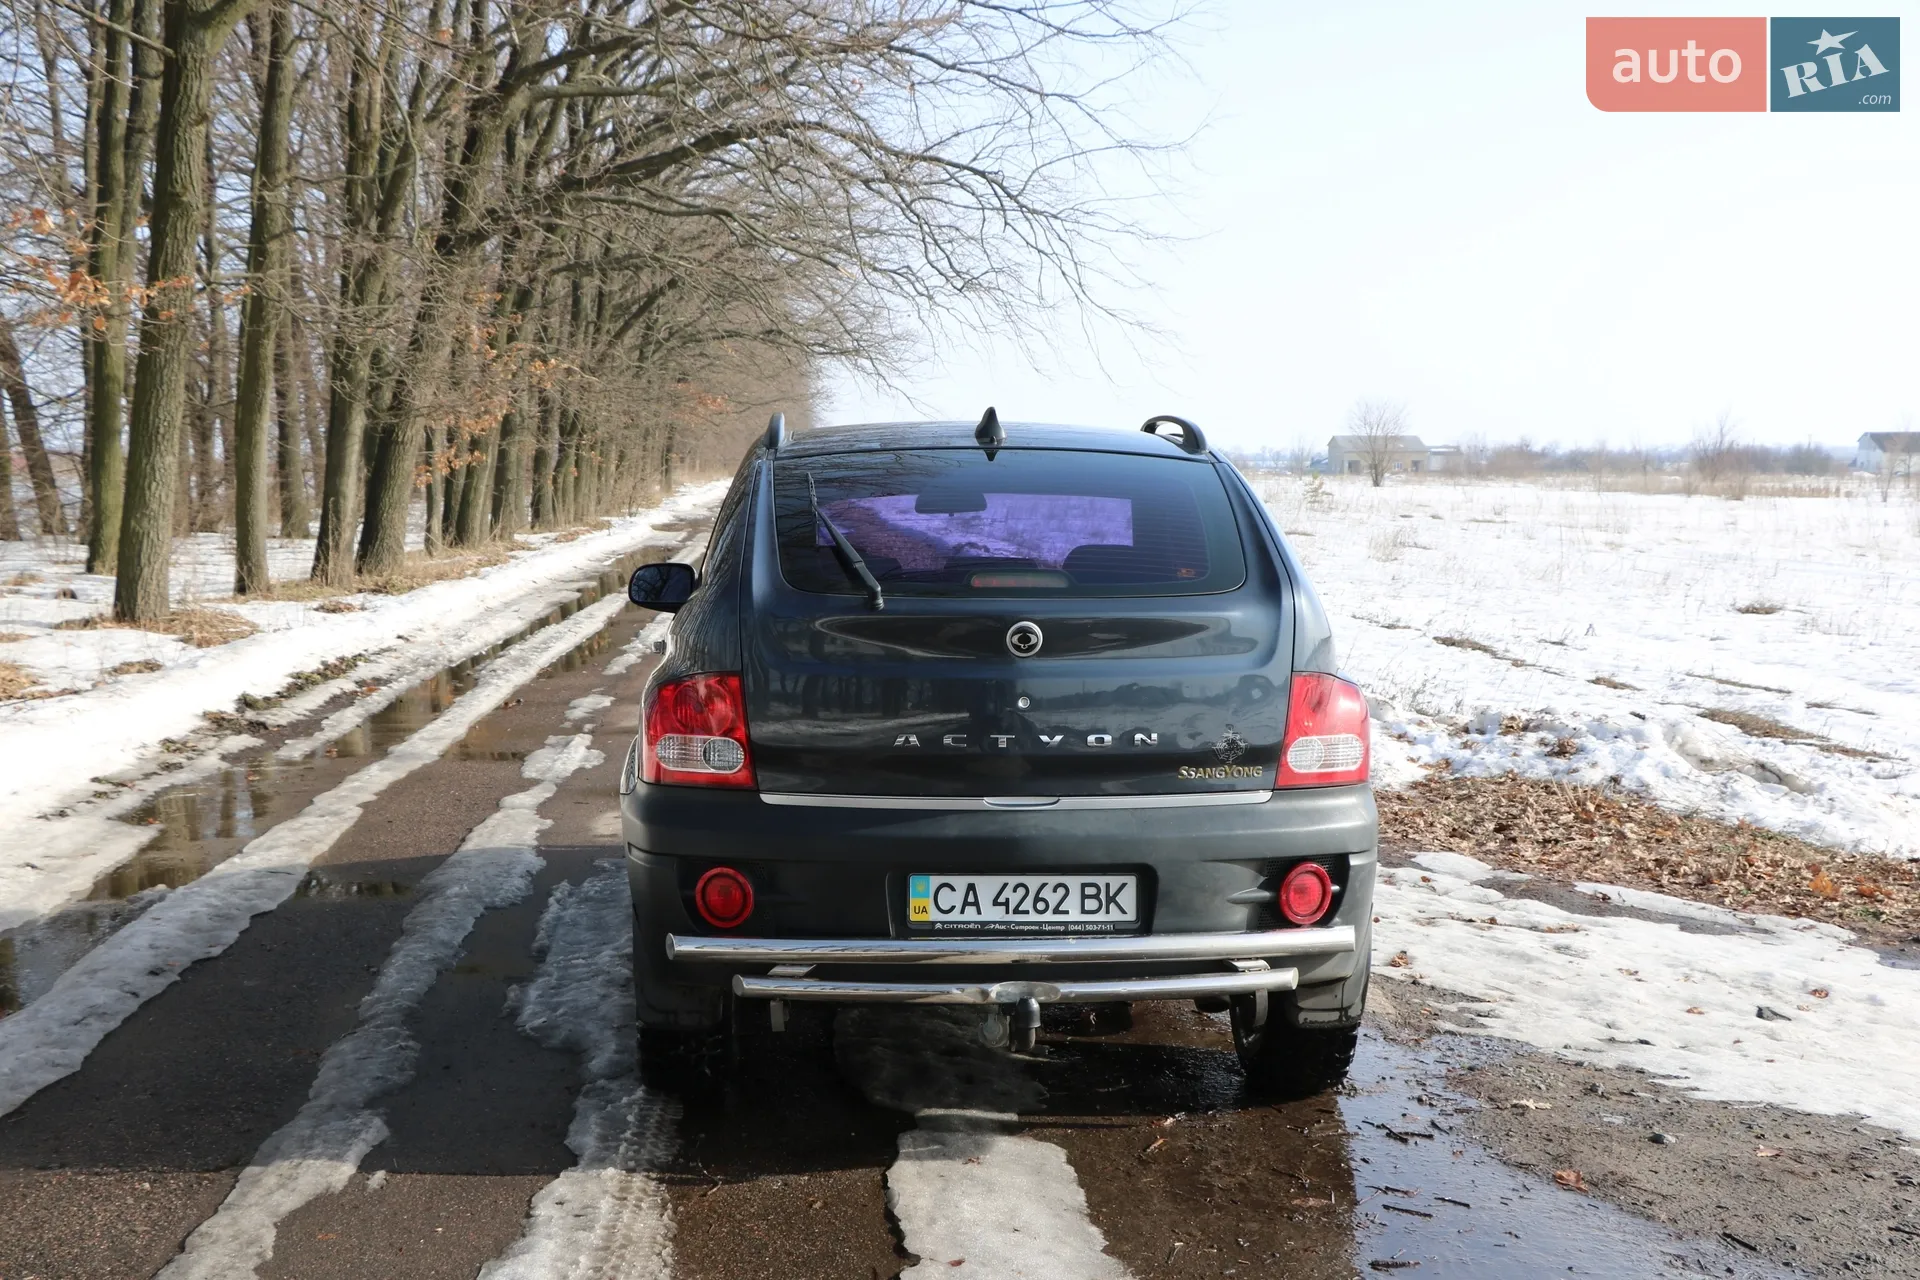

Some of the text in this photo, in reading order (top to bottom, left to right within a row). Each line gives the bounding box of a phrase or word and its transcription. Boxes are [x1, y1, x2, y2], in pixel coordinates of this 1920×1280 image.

[893, 732, 1158, 748] ACTYON
[933, 882, 1129, 915] CA 4262 BK
[913, 905, 928, 915] UA
